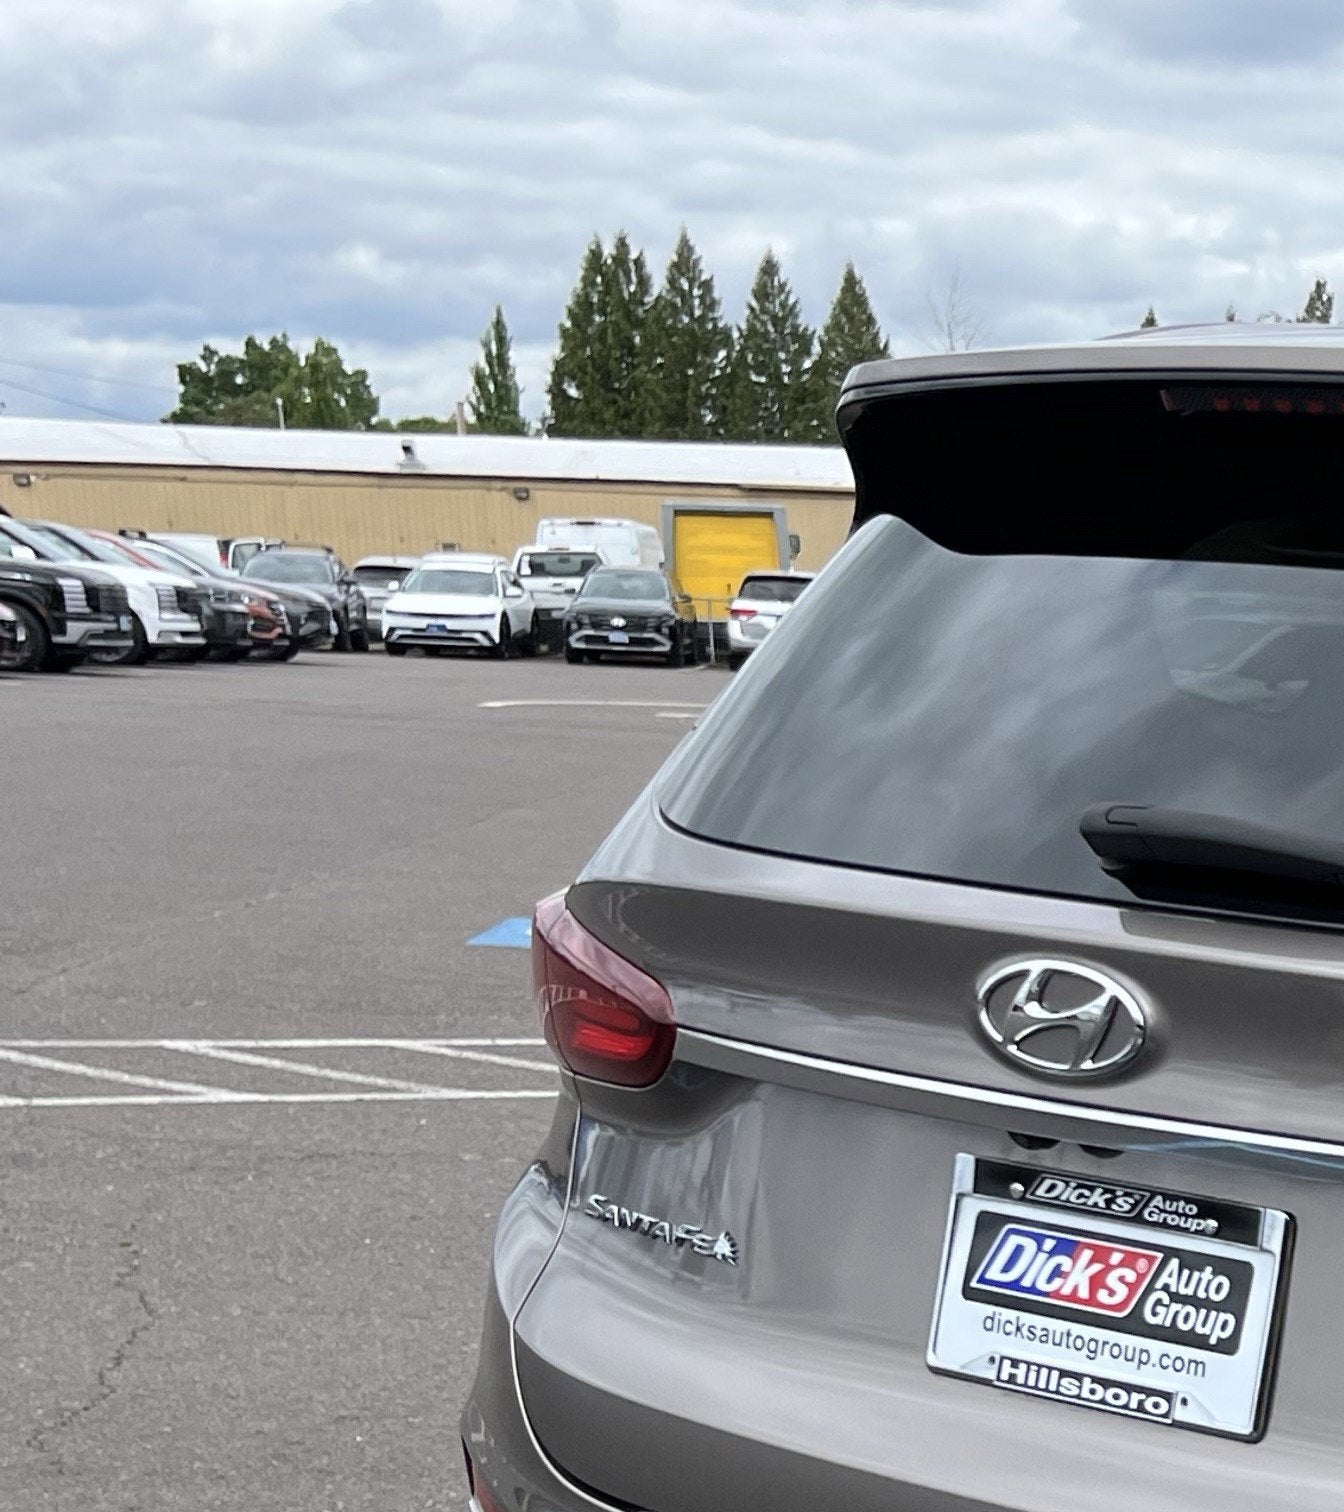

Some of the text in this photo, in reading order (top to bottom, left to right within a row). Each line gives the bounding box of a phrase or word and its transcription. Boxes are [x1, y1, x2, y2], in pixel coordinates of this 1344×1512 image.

[1035, 1178, 1199, 1216] Dick's Auto
[1142, 1208, 1207, 1233] Group
[984, 1234, 1231, 1305] Dick's Auto
[982, 1310, 1206, 1378] dicksautogroup.com
[1142, 1290, 1236, 1346] Group
[1000, 1358, 1170, 1415] Hillsboro
